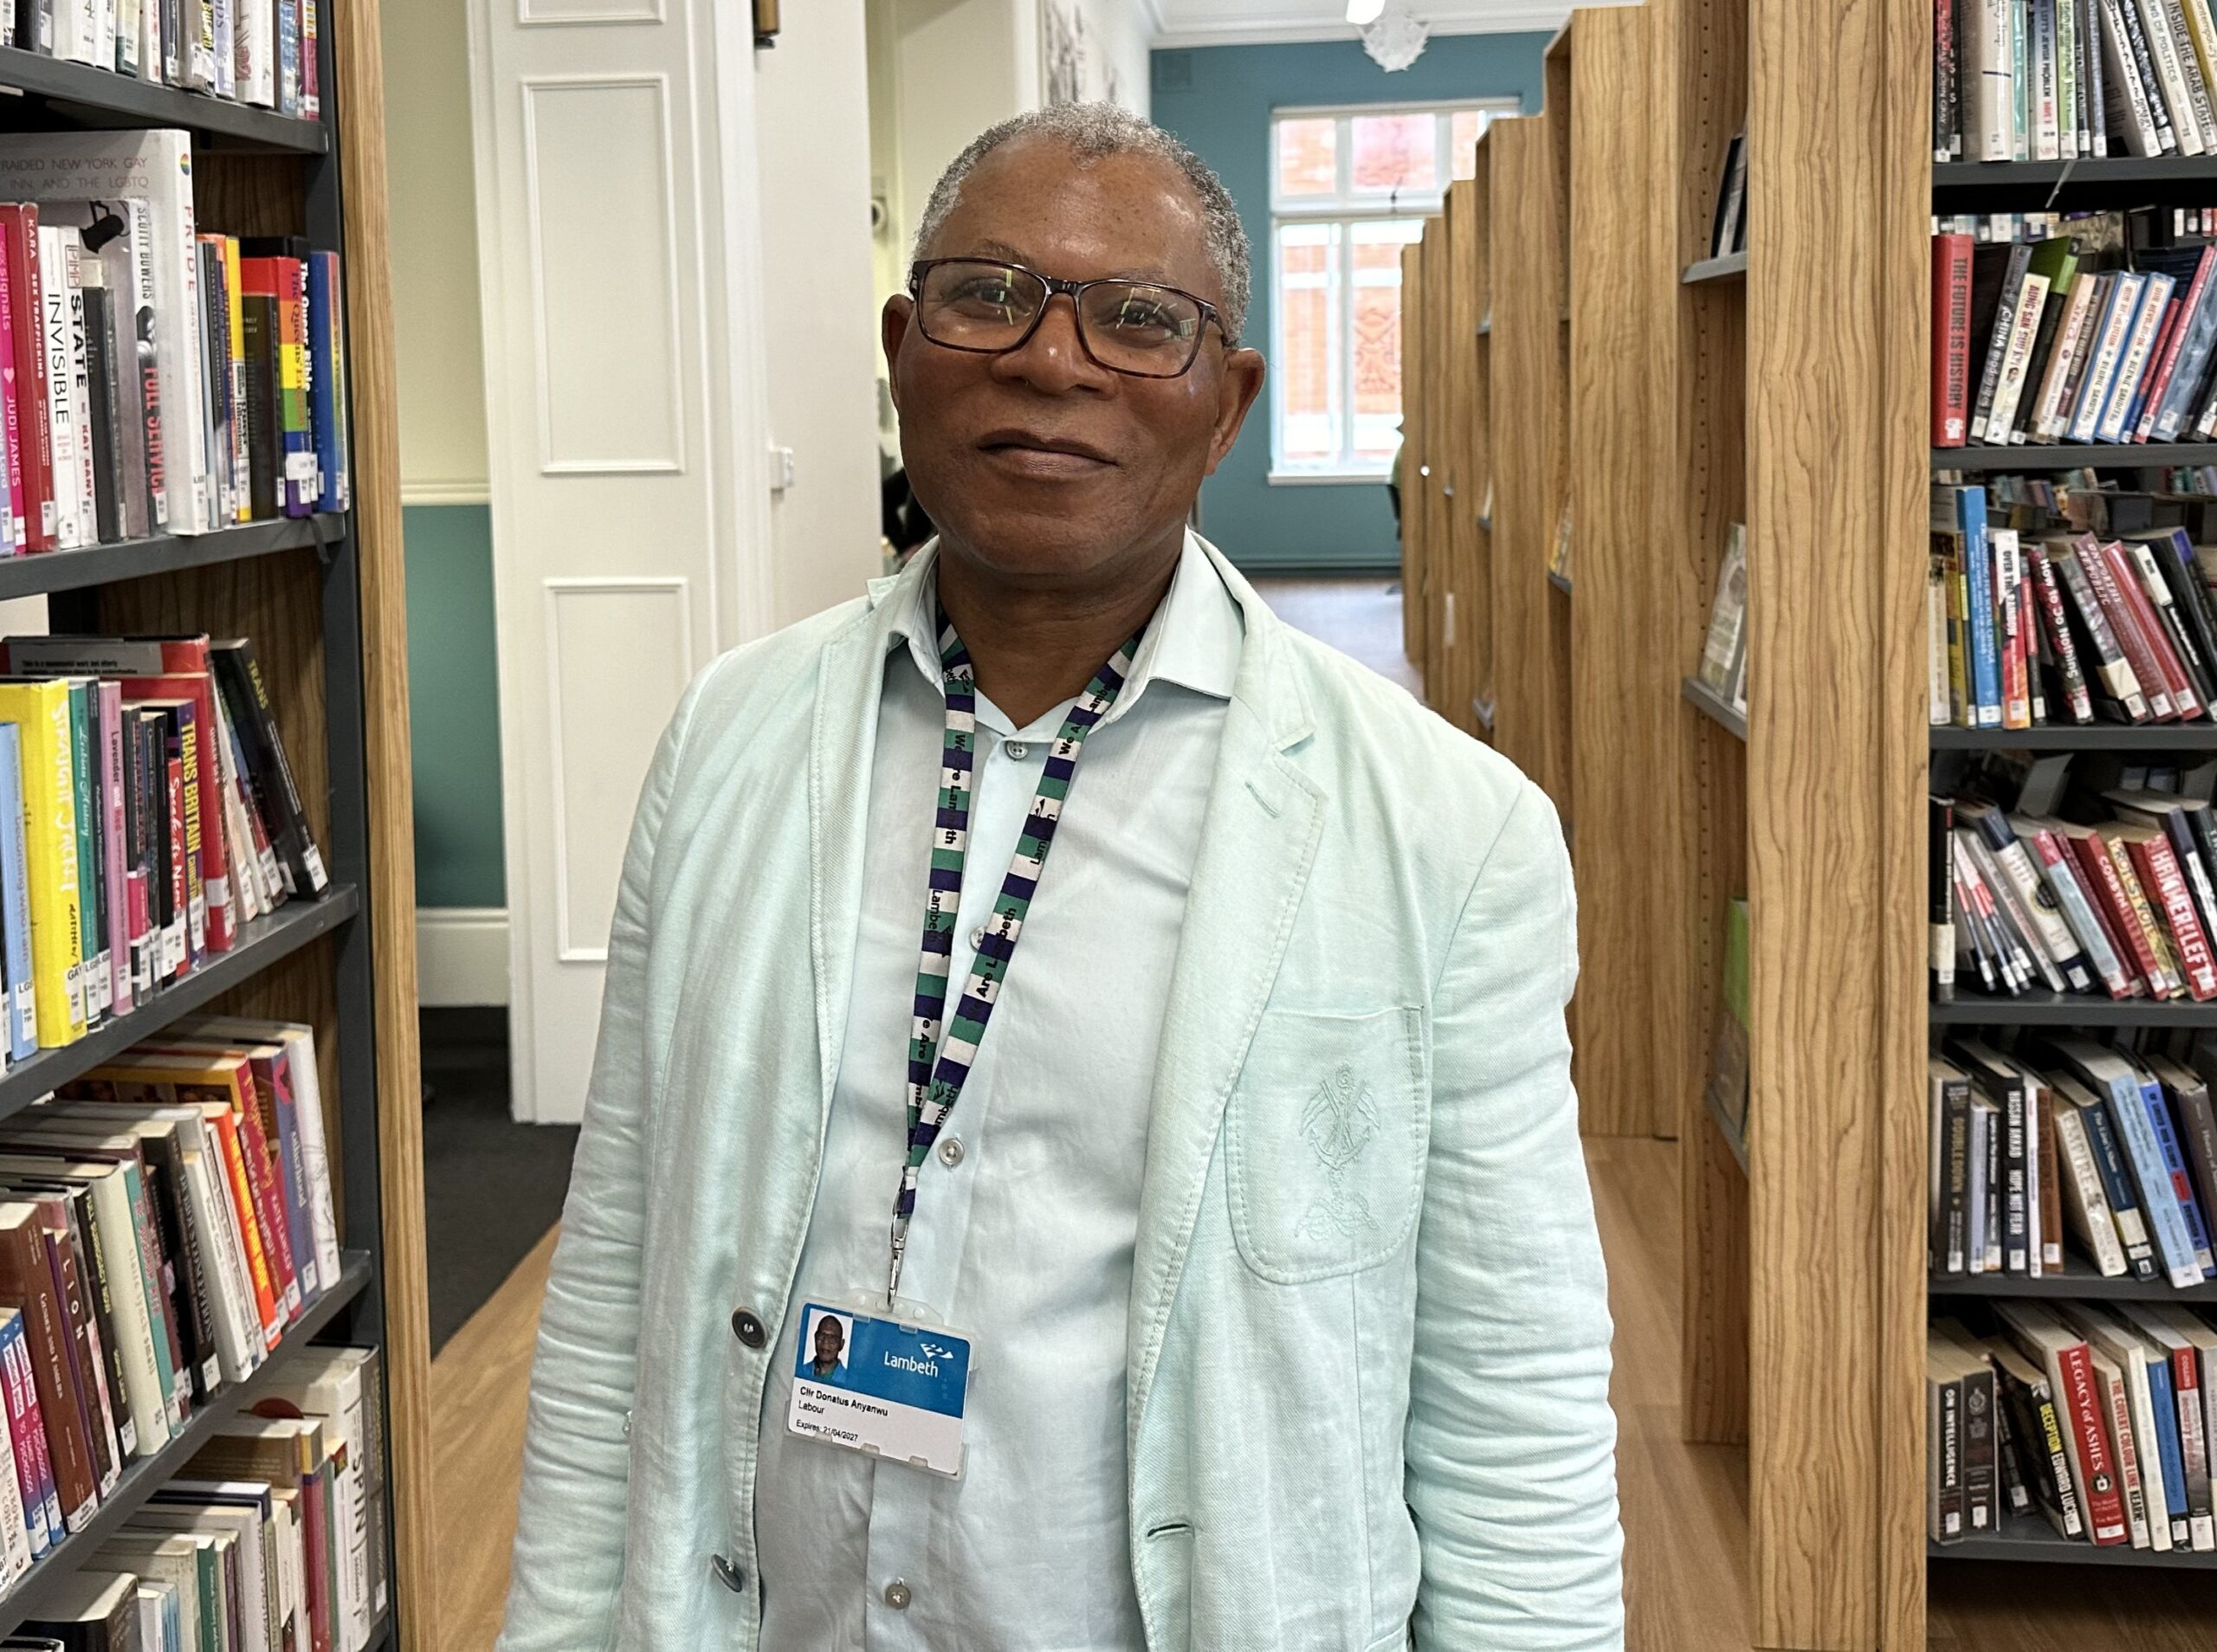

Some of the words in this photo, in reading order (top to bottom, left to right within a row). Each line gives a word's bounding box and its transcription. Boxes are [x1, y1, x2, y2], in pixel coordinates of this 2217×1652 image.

[2166, 1, 2188, 39] INSIDE
[2153, 35, 2181, 84] POLITICS
[2178, 41, 2195, 63] THE
[2042, 63, 2051, 97] PROBLEM
[2184, 63, 2203, 94] ARAB
[2, 160, 43, 171] RAIDED
[52, 159, 81, 170] NEW
[87, 158, 117, 170] YORK
[123, 157, 148, 169] GAY
[44, 178, 71, 189] AND
[78, 177, 100, 189] THE
[109, 177, 149, 189] LGBTQ
[184, 205, 197, 292] PRIDE
[68, 248, 81, 287] PIMP
[301, 262, 309, 292] The
[1953, 257, 1968, 281] THE
[27, 218, 37, 260] KARA
[33, 300, 44, 379] TRAFFICKING
[1950, 285, 1967, 332] FUTURE
[2023, 285, 2040, 311] AUNG
[301, 296, 310, 346] Queer
[1994, 309, 2013, 349] CHINA
[2019, 311, 2033, 330] SAN
[70, 294, 87, 389] STATE
[1950, 336, 1965, 350] IS
[2013, 330, 2028, 350] SUU
[48, 294, 70, 424] INVISIBLE
[304, 350, 313, 391] Bible
[144, 366, 160, 410] FULL
[1947, 353, 1964, 410] HISTORY
[7, 395, 18, 433] JUDI
[81, 424, 90, 451] KAY
[10, 437, 22, 487] JAMES
[2003, 551, 2013, 573] OVER
[2039, 558, 2056, 588] How
[2078, 549, 2111, 607] REPUBLIC
[2047, 589, 2061, 604] to
[2005, 595, 2018, 636] RAINBOW
[2052, 606, 2066, 626] Do
[2055, 627, 2080, 680] Nothing
[248, 658, 269, 710] TRANS
[111, 731, 120, 783] Lavender
[181, 720, 198, 783] TRANS
[1059, 736, 1076, 756] We
[113, 785, 123, 808] and
[114, 809, 124, 831] Red
[184, 782, 202, 855] BRITAIN
[2096, 854, 2131, 910] CORBYN
[67, 965, 82, 981] GAY
[975, 971, 993, 998] Are
[918, 1032, 931, 1060] Are
[2093, 1111, 2105, 1126] The
[2009, 1169, 2022, 1192] HOPE
[86, 1194, 95, 1221] FULL
[62, 1257, 85, 1341] LION
[883, 1351, 939, 1378] Lambeth
[2068, 1350, 2092, 1410] LEGACY
[798, 1400, 825, 1415] Labour
[816, 1390, 850, 1407] Donatus
[850, 1398, 889, 1417] Anyanwu
[1946, 1389, 1955, 1407] ON
[2039, 1403, 2062, 1454] DECEPTION
[2081, 1409, 2094, 1424] of
[2111, 1378, 2124, 1397] THE
[2126, 1468, 2138, 1489] LINE
[823, 1426, 859, 1442] 21/04/2027
[1946, 1410, 1955, 1487] INTELLIGENCE
[2084, 1425, 2104, 1472] ASHES
[2050, 1452, 2072, 1494] EDWARD
